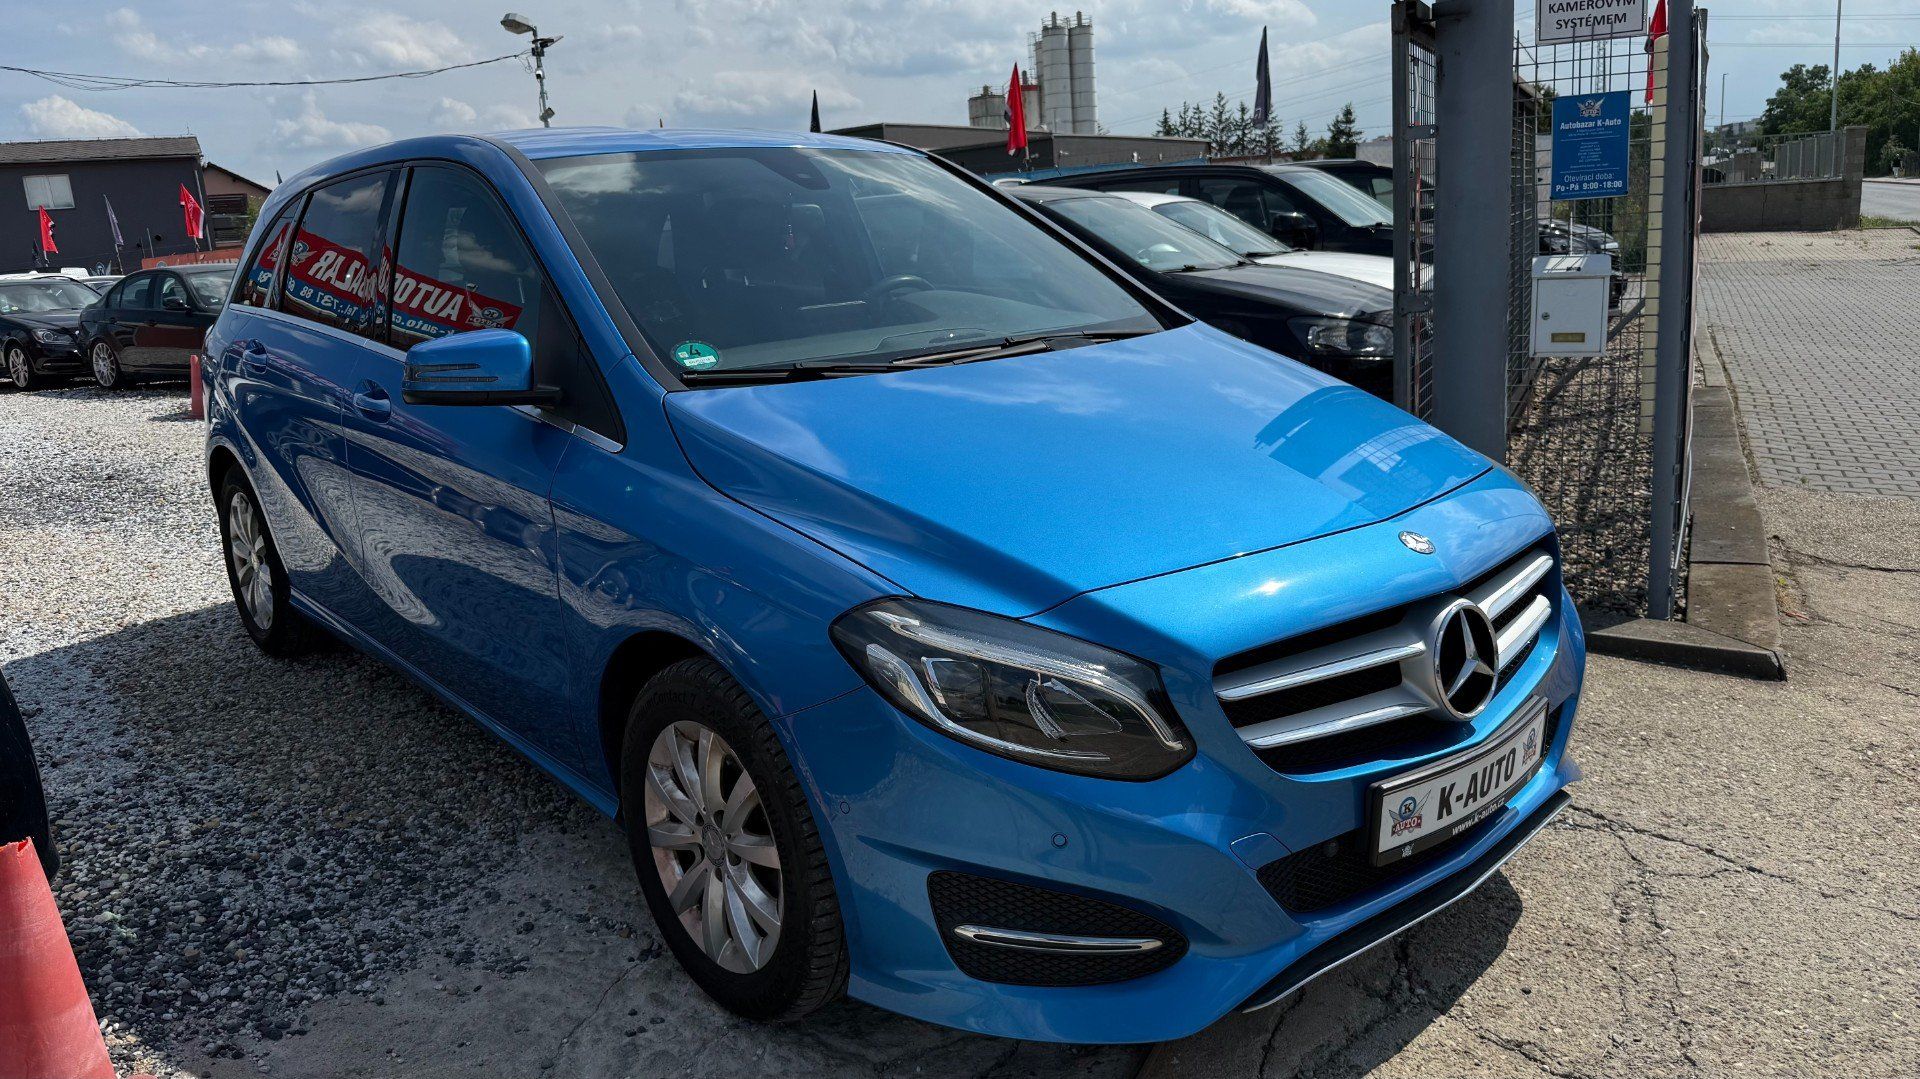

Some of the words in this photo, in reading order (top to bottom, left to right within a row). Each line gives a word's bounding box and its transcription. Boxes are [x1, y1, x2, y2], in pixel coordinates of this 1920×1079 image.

[1555, 13, 1627, 30] SYSTÉMEM
[1560, 120, 1596, 130] Autobazar
[1597, 118, 1622, 127] K-Auto
[1595, 172, 1615, 180] doba:
[689, 344, 702, 357] 4
[1436, 747, 1517, 821] K-AUTO
[1394, 817, 1418, 832] AUTO
